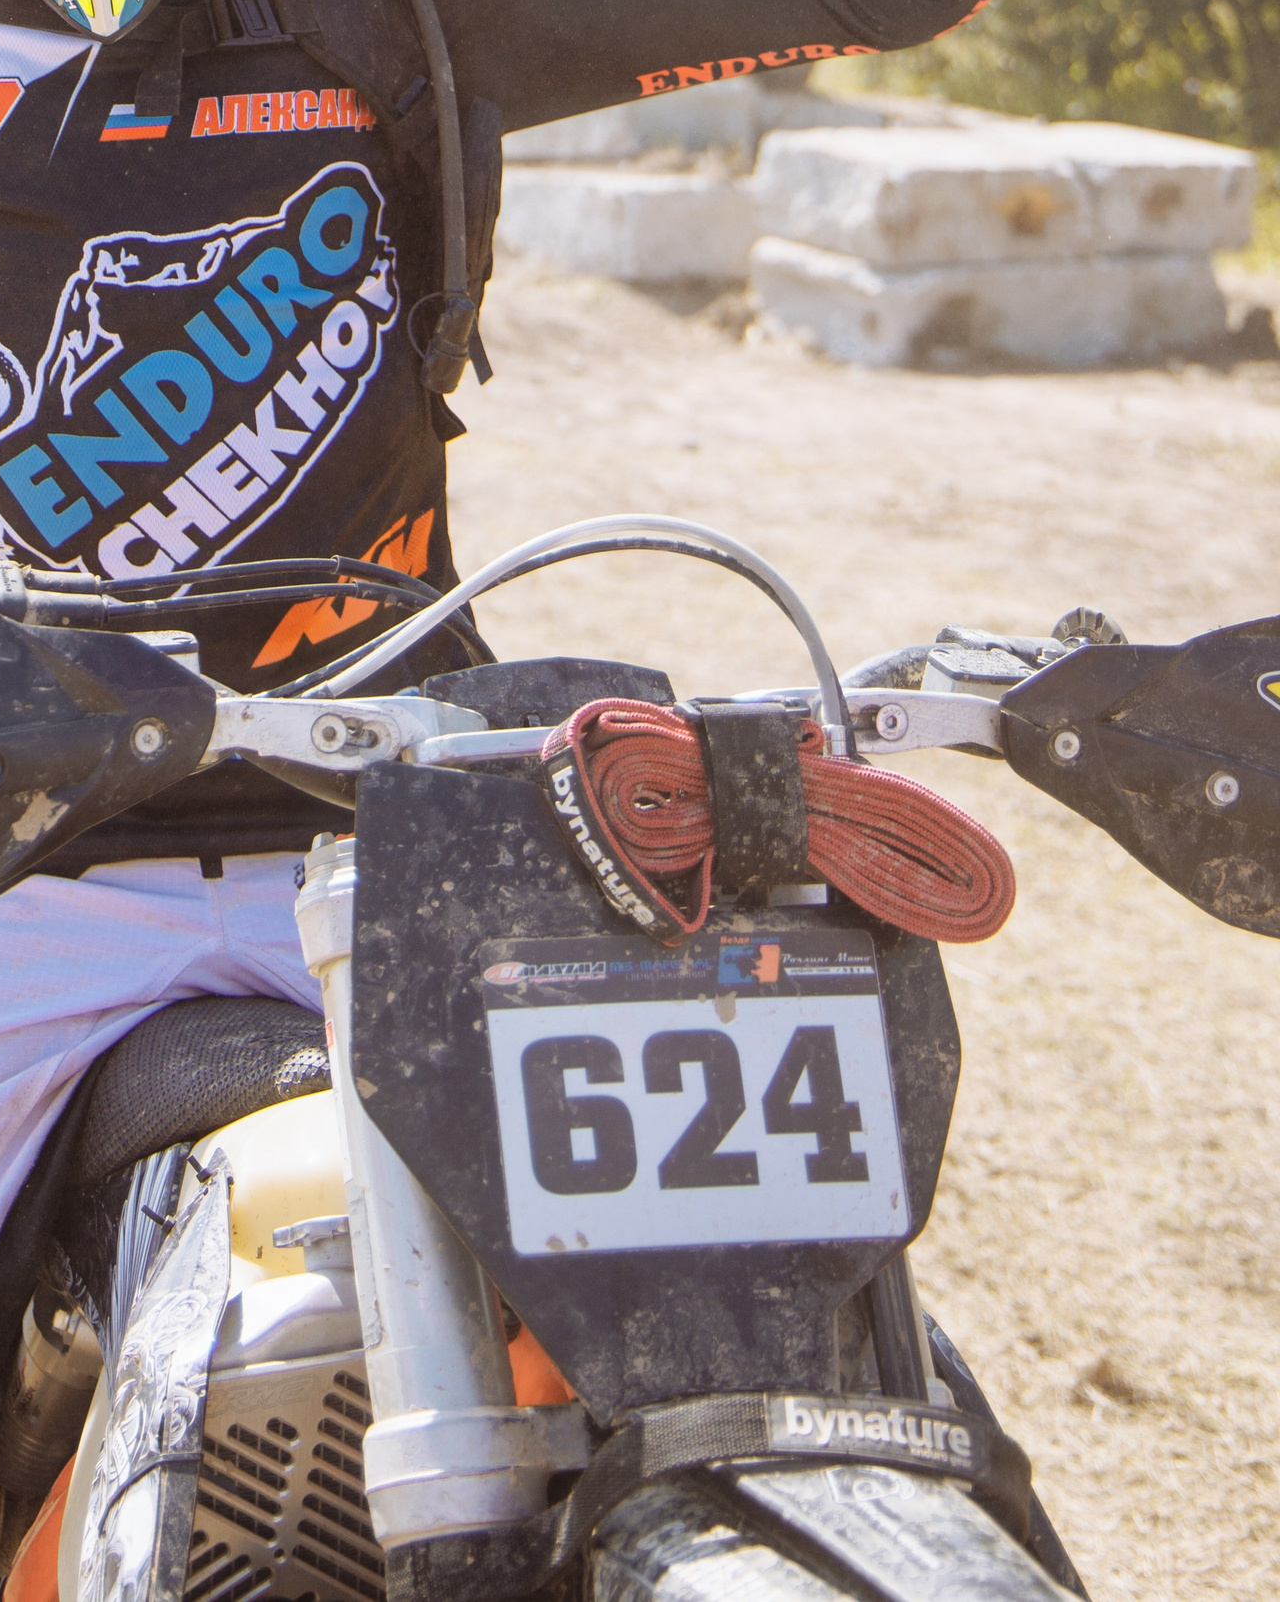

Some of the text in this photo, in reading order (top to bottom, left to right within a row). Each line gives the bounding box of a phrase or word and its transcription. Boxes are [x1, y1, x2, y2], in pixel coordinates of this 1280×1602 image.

[98, 254, 395, 593] CHEKHOV
[551, 765, 655, 926] bynature
[520, 1024, 871, 1196] 624
[784, 1397, 973, 1458] bynature
